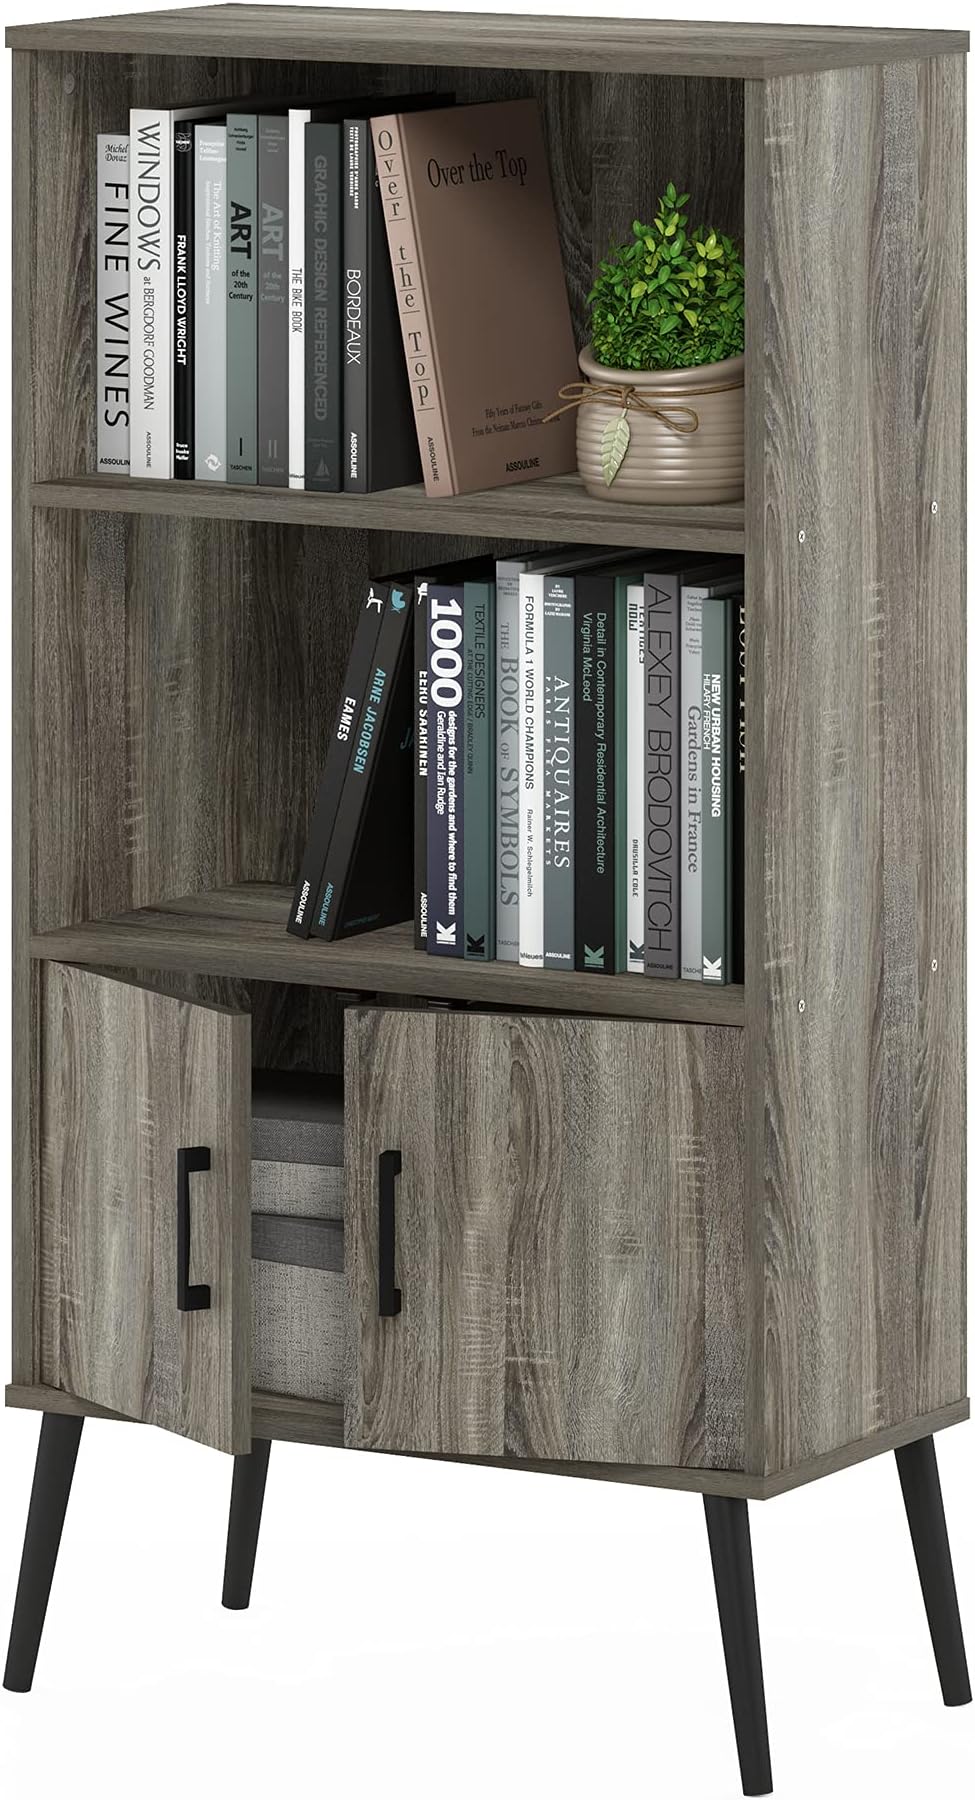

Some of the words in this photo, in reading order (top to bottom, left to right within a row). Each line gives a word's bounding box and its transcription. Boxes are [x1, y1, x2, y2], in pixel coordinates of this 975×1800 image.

[105, 144, 129, 153] Michel
[427, 158, 465, 188] Over
[469, 152, 494, 183] the
[495, 149, 528, 186] Top
[137, 122, 161, 271] WINDOWS
[213, 181, 222, 200] The
[213, 201, 221, 217] Art
[314, 155, 328, 233] GRAPHIC
[104, 182, 129, 272] FINE
[213, 220, 222, 230] of
[230, 201, 252, 260] ART
[262, 202, 283, 261] ART
[177, 235, 186, 273] FRANK
[212, 232, 222, 271] Knitting
[314, 238, 328, 301] DESIGN
[378, 130, 401, 217] Over
[399, 245, 415, 308] the
[408, 331, 429, 406] Top
[143, 276, 151, 285] at
[232, 269, 239, 277] of
[240, 269, 250, 278] the
[234, 281, 248, 289] 20th
[292, 268, 302, 284] THE
[177, 276, 186, 314] LLOYD
[229, 291, 253, 302] Century
[291, 288, 303, 307] BIKE
[143, 288, 155, 347] BERGDORF
[292, 311, 303, 333] BOOK
[346, 269, 361, 364] BORDEAUX
[104, 293, 129, 427] WINES
[177, 317, 186, 365] WRIGHT
[143, 349, 155, 410] GOODMAN
[314, 307, 328, 420] REFERENCED
[427, 436, 440, 482] ASSOULINE
[506, 457, 540, 473] ASSOULINE
[474, 604, 485, 649] TEXTILE
[500, 622, 510, 649] THE
[525, 596, 534, 655] FORMULA
[580, 612, 593, 653] Virginia
[596, 612, 607, 644] Detail
[430, 599, 462, 707] 1000
[597, 647, 607, 657] in
[647, 583, 672, 718] ALEXEY
[372, 667, 386, 705] ARNE
[474, 653, 486, 719] DESIGNERS
[500, 657, 519, 736] BOOK
[525, 668, 534, 713] WORLD
[583, 657, 593, 702] McLeod
[594, 660, 607, 740] Contemporary
[703, 674, 711, 708] HILARY
[711, 674, 721, 705] NEW
[336, 696, 356, 742] EAMES
[436, 710, 446, 752] Geraldine
[446, 710, 458, 745] designs
[703, 710, 711, 750] FRENCH
[711, 708, 721, 754] URBAN
[353, 706, 380, 775] JACOBSEN
[419, 709, 428, 776] SAARINEN
[448, 746, 458, 760] for
[500, 742, 510, 761] OF
[525, 717, 534, 789] CHAMPIONS
[688, 706, 702, 781] Gardens
[436, 753, 446, 770] and
[436, 771, 446, 786] Ian
[448, 760, 457, 776] the
[550, 675, 571, 868] ANTIQUAIRES
[596, 743, 607, 804] Residential
[434, 787, 446, 815] Rudge
[446, 776, 458, 813] gardens
[688, 787, 702, 804] in
[711, 757, 721, 817] HOUSING
[448, 814, 457, 831] and
[500, 767, 519, 906] SYMBOLS
[527, 835, 533, 844] W.
[596, 807, 607, 874] Architecture
[647, 729, 672, 952] BRODOVITCH
[688, 810, 702, 873] France
[448, 832, 457, 861] where
[448, 862, 456, 872] to
[294, 879, 311, 925] ASSOULINE
[448, 873, 457, 891] find
[318, 881, 334, 927] ASSOULINE
[420, 892, 428, 937] ASSOULINE
[448, 892, 457, 915] them
[545, 952, 571, 960] ASSOULINE
[646, 962, 673, 970] ASSOULINE
